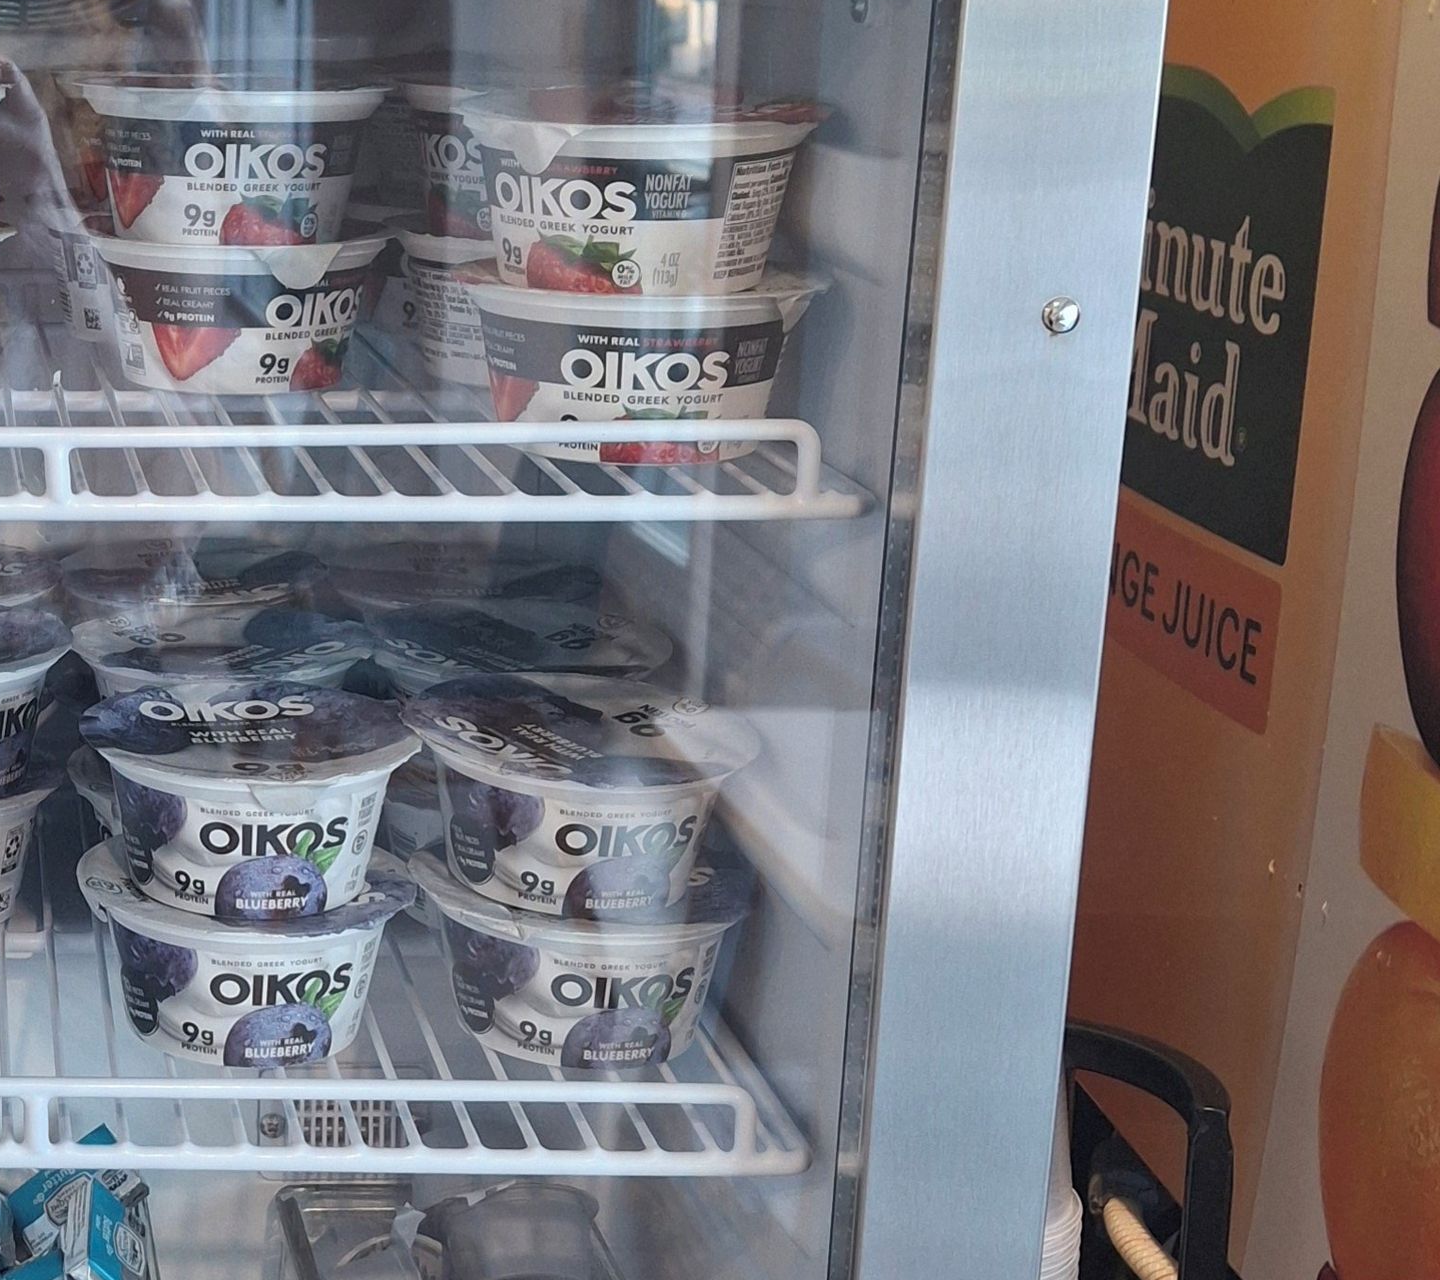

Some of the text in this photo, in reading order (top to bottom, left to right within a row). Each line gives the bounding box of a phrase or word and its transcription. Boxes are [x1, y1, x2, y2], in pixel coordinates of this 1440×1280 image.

[201, 130, 227, 138] WITH
[230, 130, 255, 138] REAL
[184, 143, 327, 180] OIKOS
[187, 181, 321, 192] BLENDED GREEK YOGURT
[645, 174, 693, 192] NONFAT
[495, 171, 637, 221] OIKOS
[644, 191, 691, 209] YOGURT
[183, 203, 217, 228] 9g
[182, 228, 218, 237] PROTEIN
[500, 214, 634, 236] BLENDED GREEK YOGURT
[502, 237, 522, 265] 9g
[163, 310, 215, 323] 9g PROTEIN
[265, 328, 338, 341] BLENDED GREEK
[577, 334, 608, 345] WITH
[611, 335, 640, 346] REAL
[259, 353, 290, 376] 9g
[560, 348, 730, 391] OIKOS
[255, 376, 290, 384] PROTEIN
[563, 391, 724, 405] BLENDED GREEK YOGURT
[1162, 579, 1262, 685] JUICE
[138, 695, 315, 722] OIKOS
[190, 727, 292, 738] WITH REAL
[190, 733, 297, 744] BLUEBERRY
[200, 807, 241, 817] BLENDED
[559, 808, 603, 818] BLENDED
[199, 816, 348, 857] OIKOS
[554, 814, 698, 858] OIKOS
[174, 870, 206, 895] 9g
[520, 870, 556, 896] 9g
[174, 892, 210, 906] PROTEIN
[276, 889, 296, 898] REAL
[517, 891, 557, 906] PROTEIN
[625, 889, 645, 897] REAL
[235, 896, 309, 911] BLUEBERRY
[585, 894, 655, 910] BLUEBERRY
[211, 956, 323, 968] BLENDED GREEK YOGURT
[209, 962, 353, 1007] OIKOS
[550, 966, 696, 1010] OIKOS
[182, 1021, 214, 1046] 9g
[519, 1019, 553, 1046] 9g
[284, 1036, 304, 1045] REAL
[623, 1040, 644, 1048] REAL
[181, 1042, 218, 1056] PROTEIN
[244, 1043, 314, 1058] BLUEBERRY
[517, 1041, 556, 1056] PROTEIN
[583, 1047, 655, 1061] BLUEBERRY
